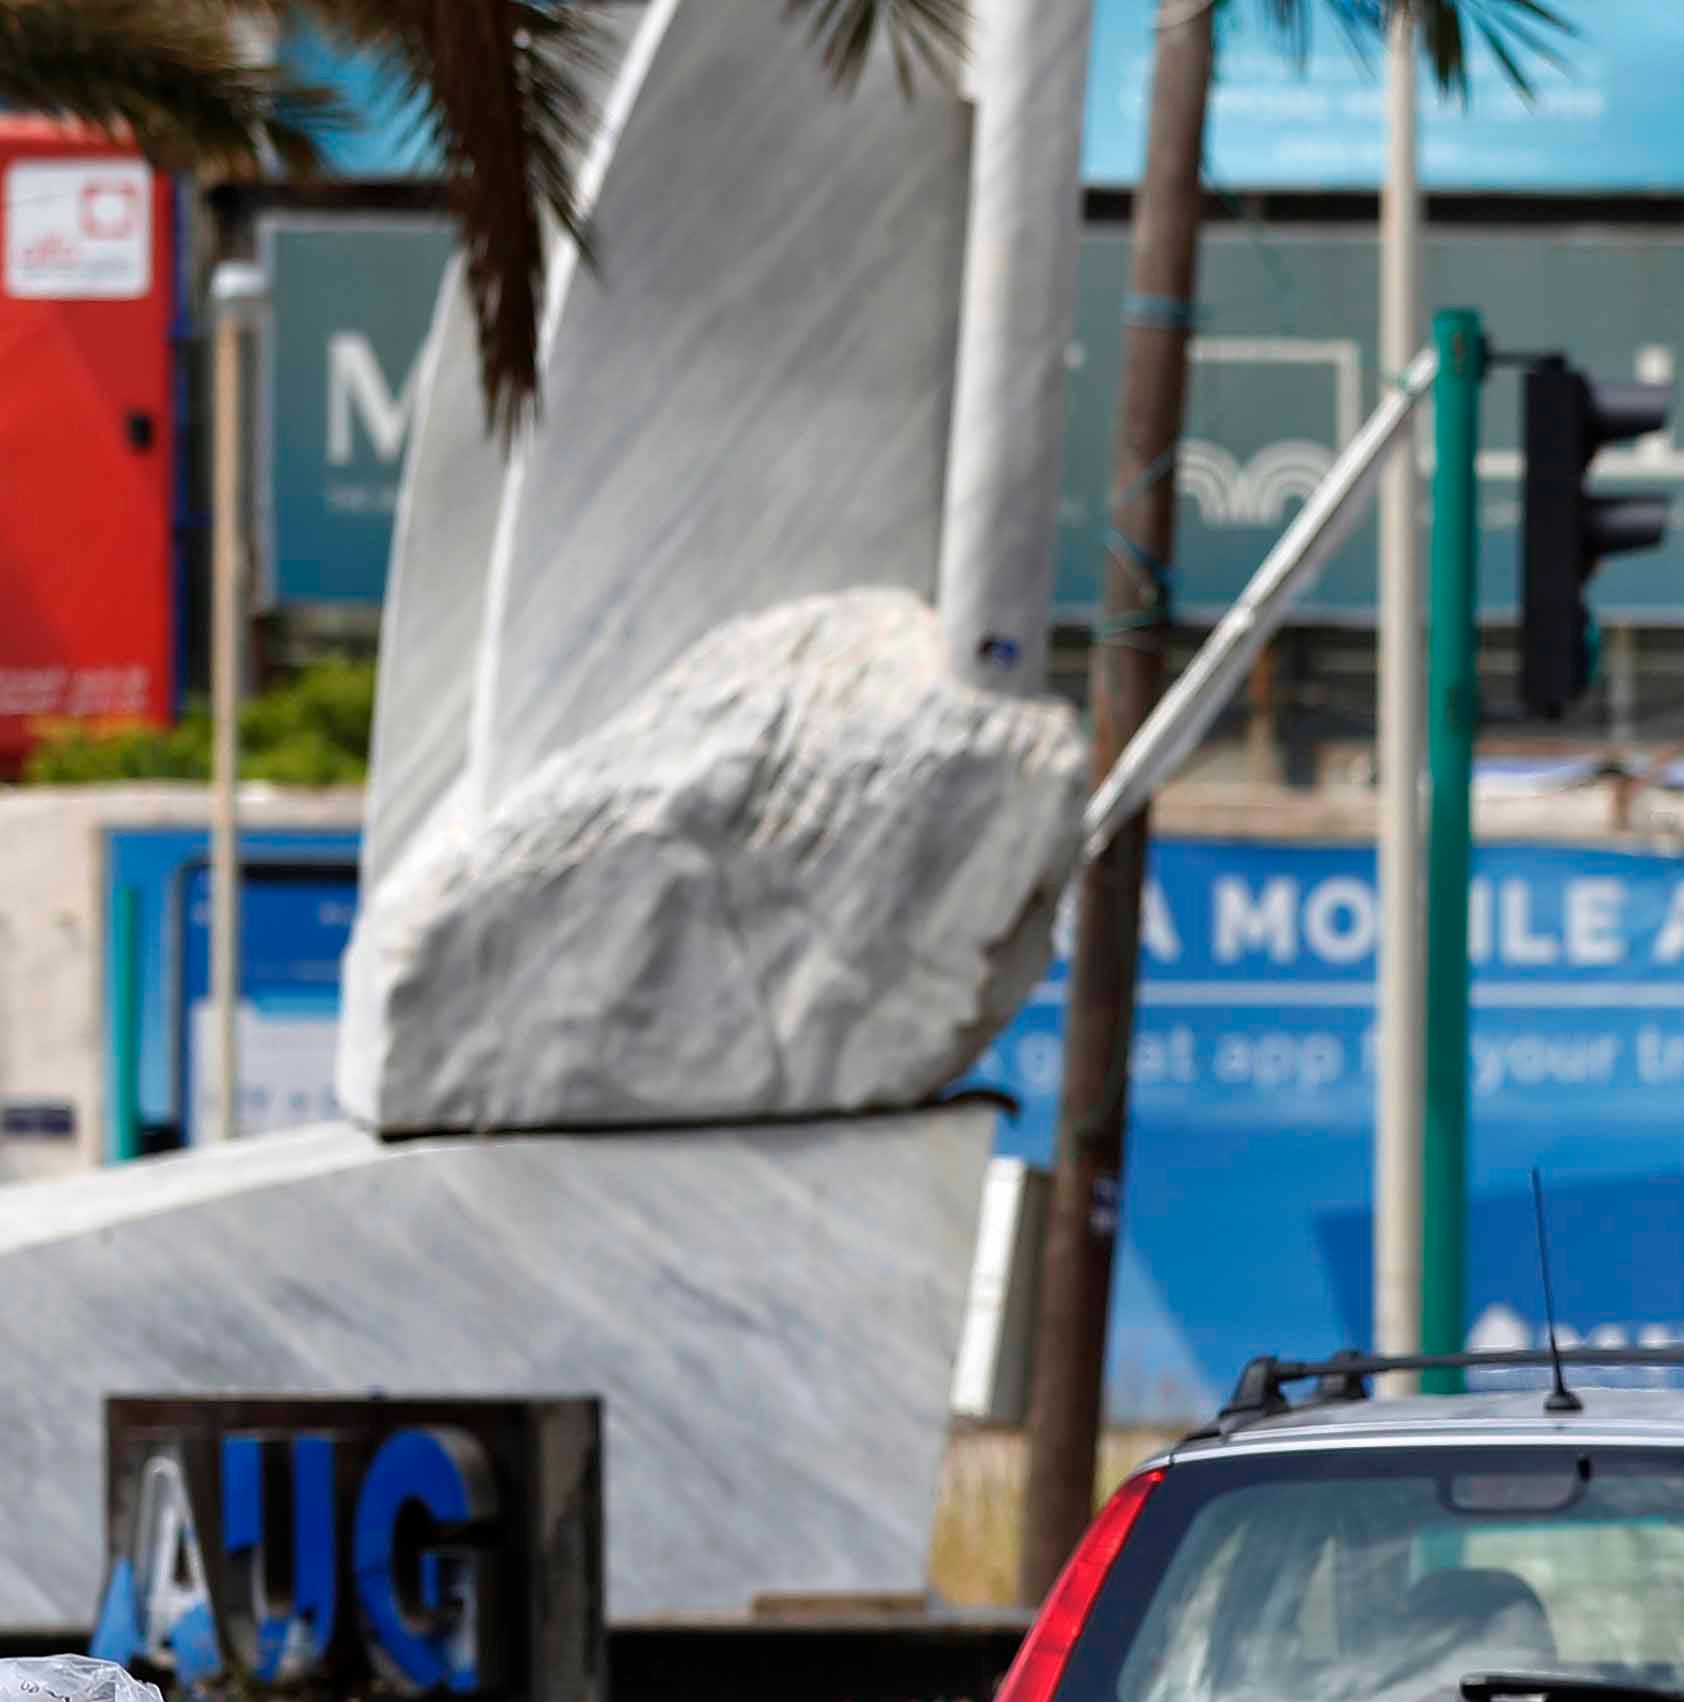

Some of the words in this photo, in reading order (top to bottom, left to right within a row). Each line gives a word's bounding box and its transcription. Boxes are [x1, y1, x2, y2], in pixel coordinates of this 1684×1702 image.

[1212, 875, 1628, 966] MOILE
[1214, 1030, 1344, 1092] app
[1468, 1033, 1618, 1098] your
[90, 1428, 485, 1697] AUG
